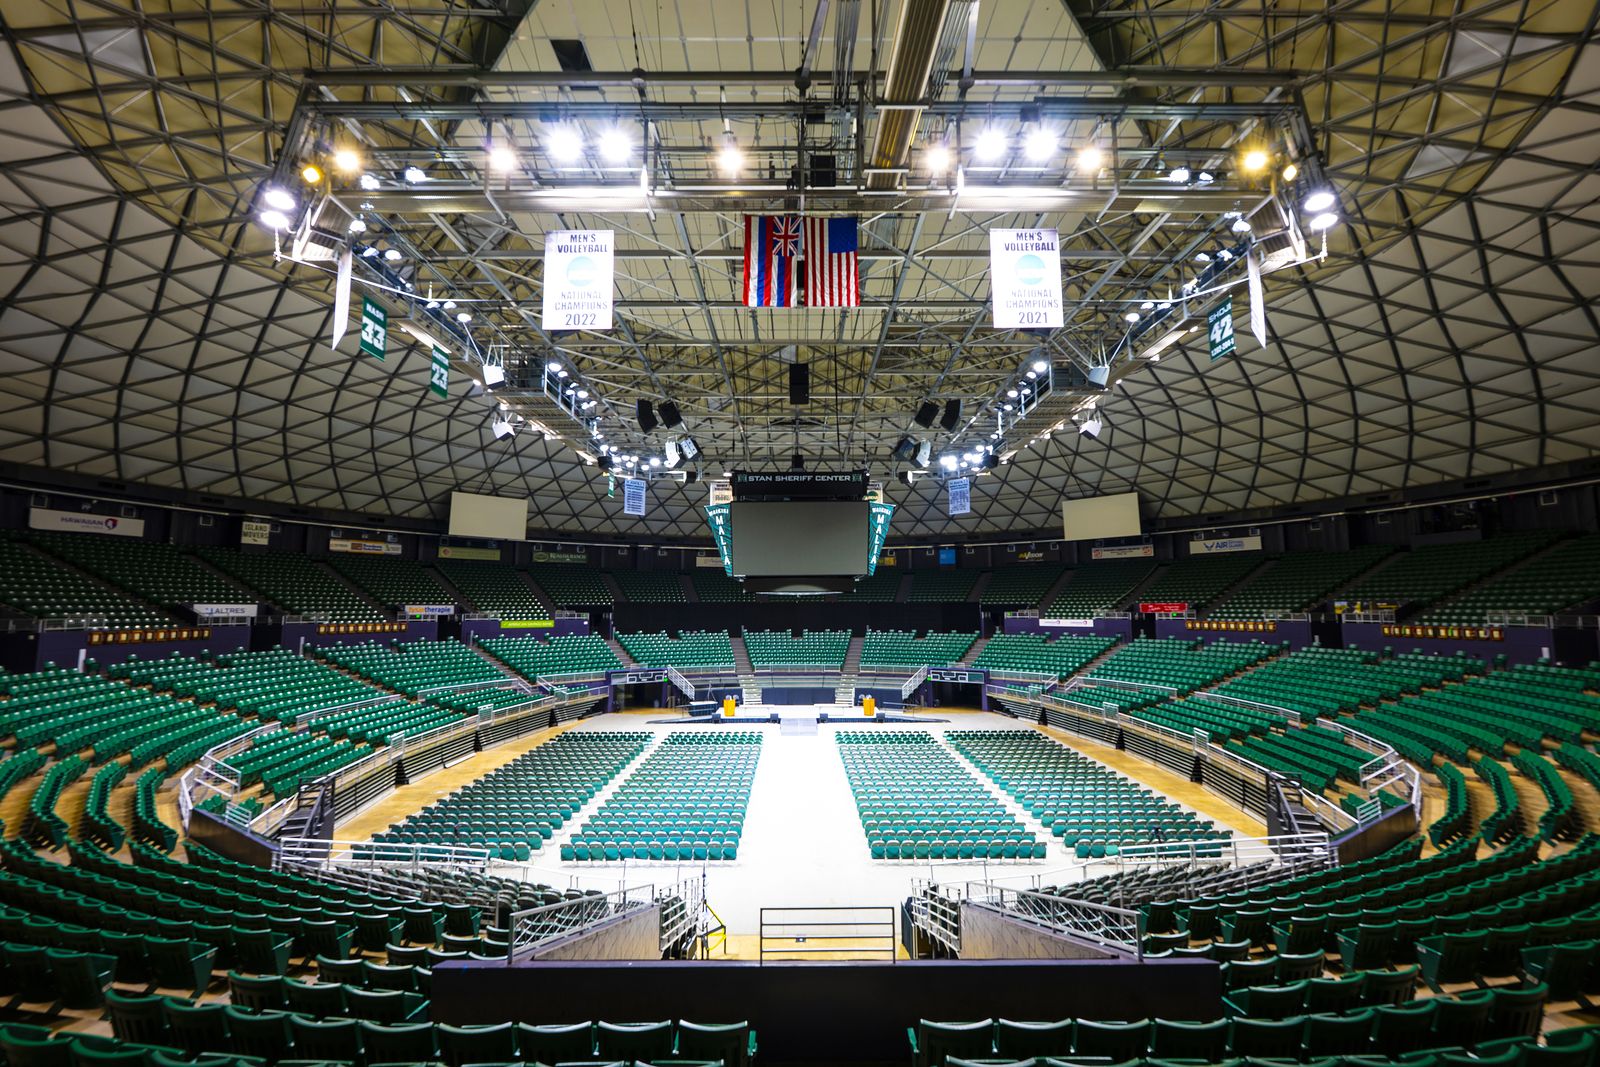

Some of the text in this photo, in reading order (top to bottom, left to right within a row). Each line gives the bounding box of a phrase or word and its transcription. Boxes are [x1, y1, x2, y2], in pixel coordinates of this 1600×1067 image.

[570, 233, 596, 243] MEN'S
[1016, 231, 1043, 241] MEN'S
[557, 244, 608, 253] VOLLEYBALL
[1004, 242, 1056, 251] VOLLEYBALL
[561, 290, 602, 299] NATIONAL
[1011, 288, 1053, 298] NATIONAL
[554, 301, 608, 311] CHAMPIONS
[1006, 298, 1059, 309] CHAMPIONS
[565, 313, 596, 326] 2022
[1018, 311, 1048, 324] 2021
[361, 315, 386, 351] 33
[1210, 313, 1233, 344] 42
[431, 362, 448, 390] 23
[715, 515, 731, 565] MALIA
[870, 514, 885, 564] MALIA
[1216, 541, 1228, 549] AIR
